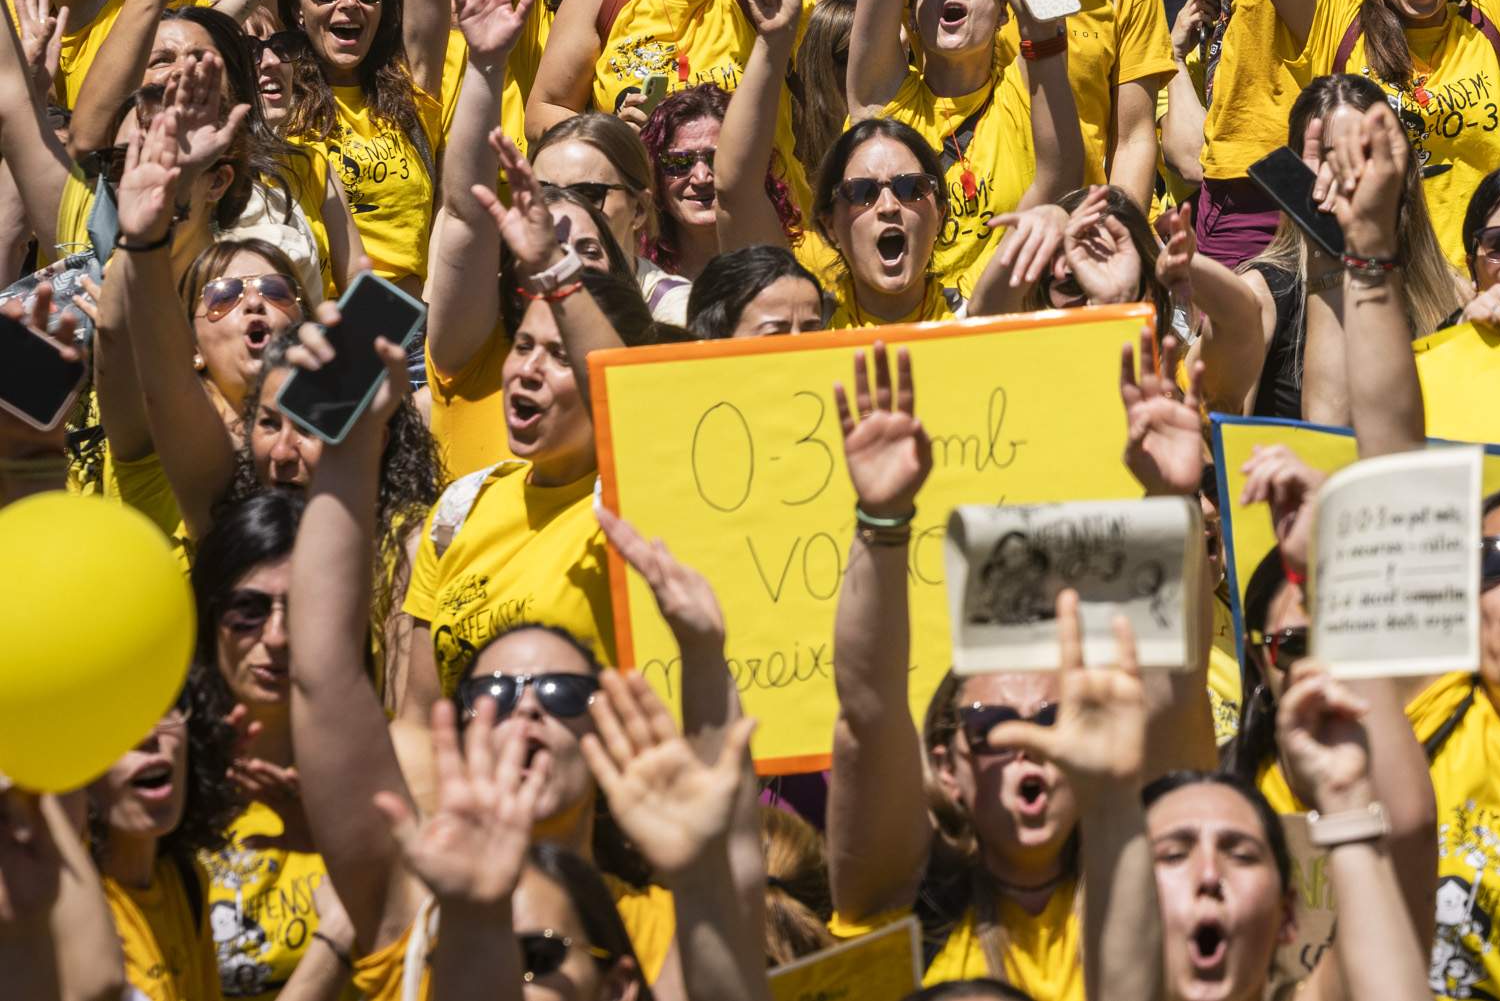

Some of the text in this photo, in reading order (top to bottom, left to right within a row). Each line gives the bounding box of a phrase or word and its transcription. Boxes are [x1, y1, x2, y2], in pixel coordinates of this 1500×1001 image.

[1442, 103, 1499, 138] 0-3
[373, 158, 410, 184] 0-3
[690, 390, 835, 513] 0-3
